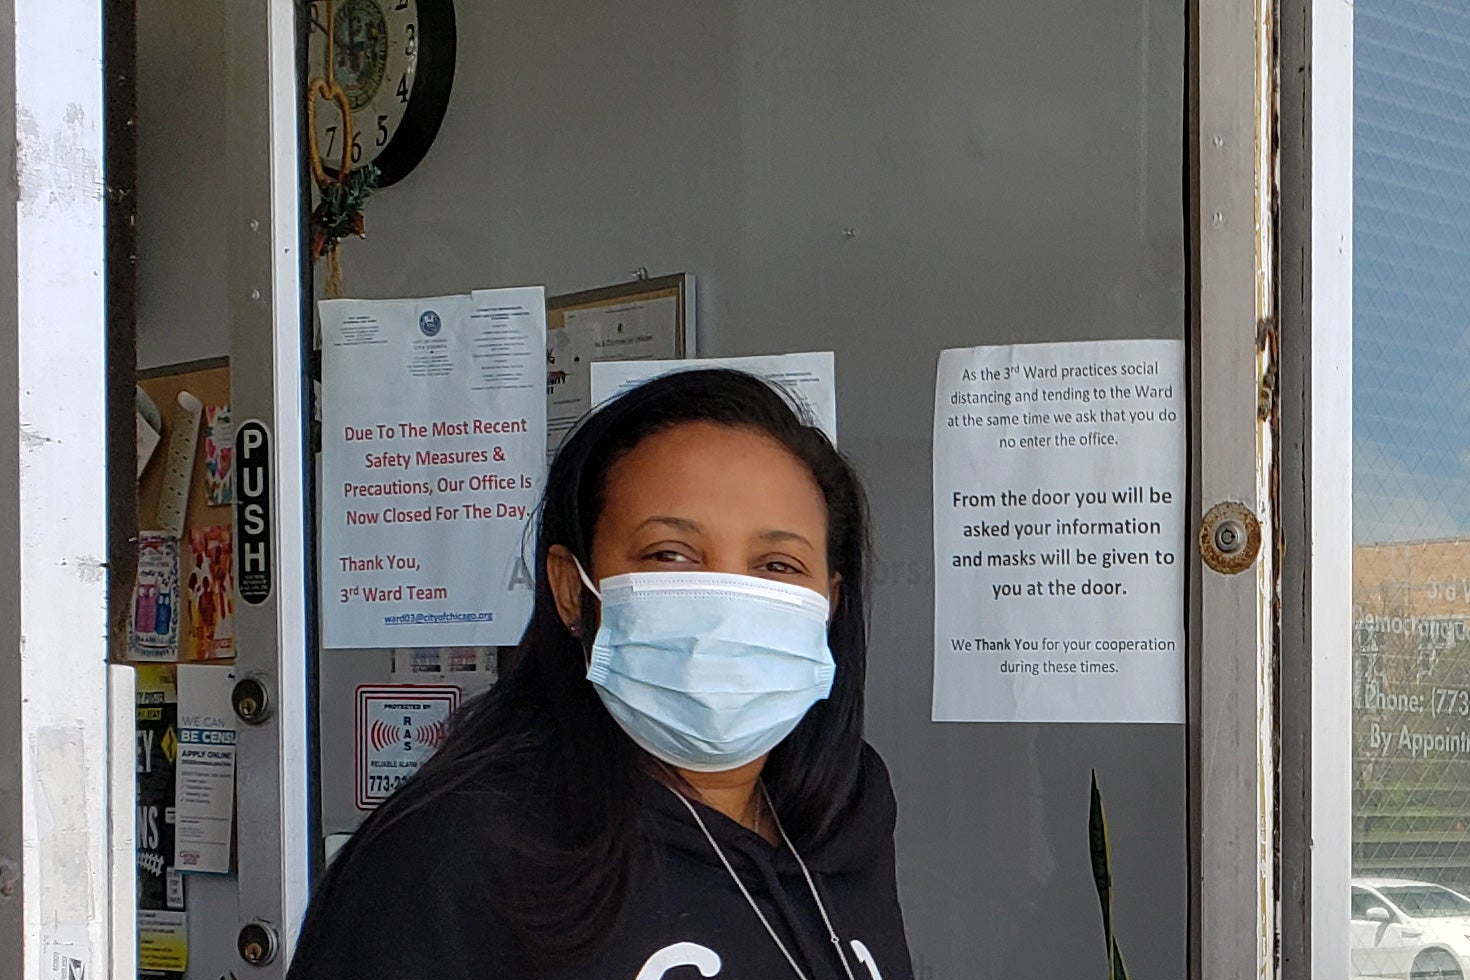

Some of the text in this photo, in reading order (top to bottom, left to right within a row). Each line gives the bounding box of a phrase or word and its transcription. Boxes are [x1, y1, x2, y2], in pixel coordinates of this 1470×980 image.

[396, 73, 408, 103] 4
[376, 115, 388, 146] 5
[325, 126, 337, 158] 7
[351, 130, 362, 163] 6
[962, 361, 1158, 381] As the 3rd Ward practices social
[951, 384, 1173, 405] distancing and tending to the Ward
[947, 408, 1176, 427] at the same time we ask that you do
[345, 418, 527, 441] Due To The Most Recent
[999, 432, 1118, 448] no enter the office.
[365, 447, 505, 469] Safety Measures &
[344, 474, 532, 497] Precautions, Our Office Is
[243, 430, 265, 572] PUSH
[952, 487, 1172, 508] From the door you will be
[347, 503, 530, 525] Now Closed For The Day.
[963, 518, 1161, 539] asked your information
[340, 555, 420, 571] Thank You,
[952, 549, 1175, 568] and masks will be given to
[340, 586, 447, 602] 3rd Ward Team
[992, 579, 1127, 599] you at the door.
[951, 638, 1175, 653] We Thank You for your cooperation
[1000, 660, 1118, 675] during these times.
[1365, 684, 1424, 713] Phone:
[182, 716, 225, 727] WE CAN
[181, 730, 199, 742] BE
[403, 716, 412, 751] RAS
[1370, 723, 1391, 757] By
